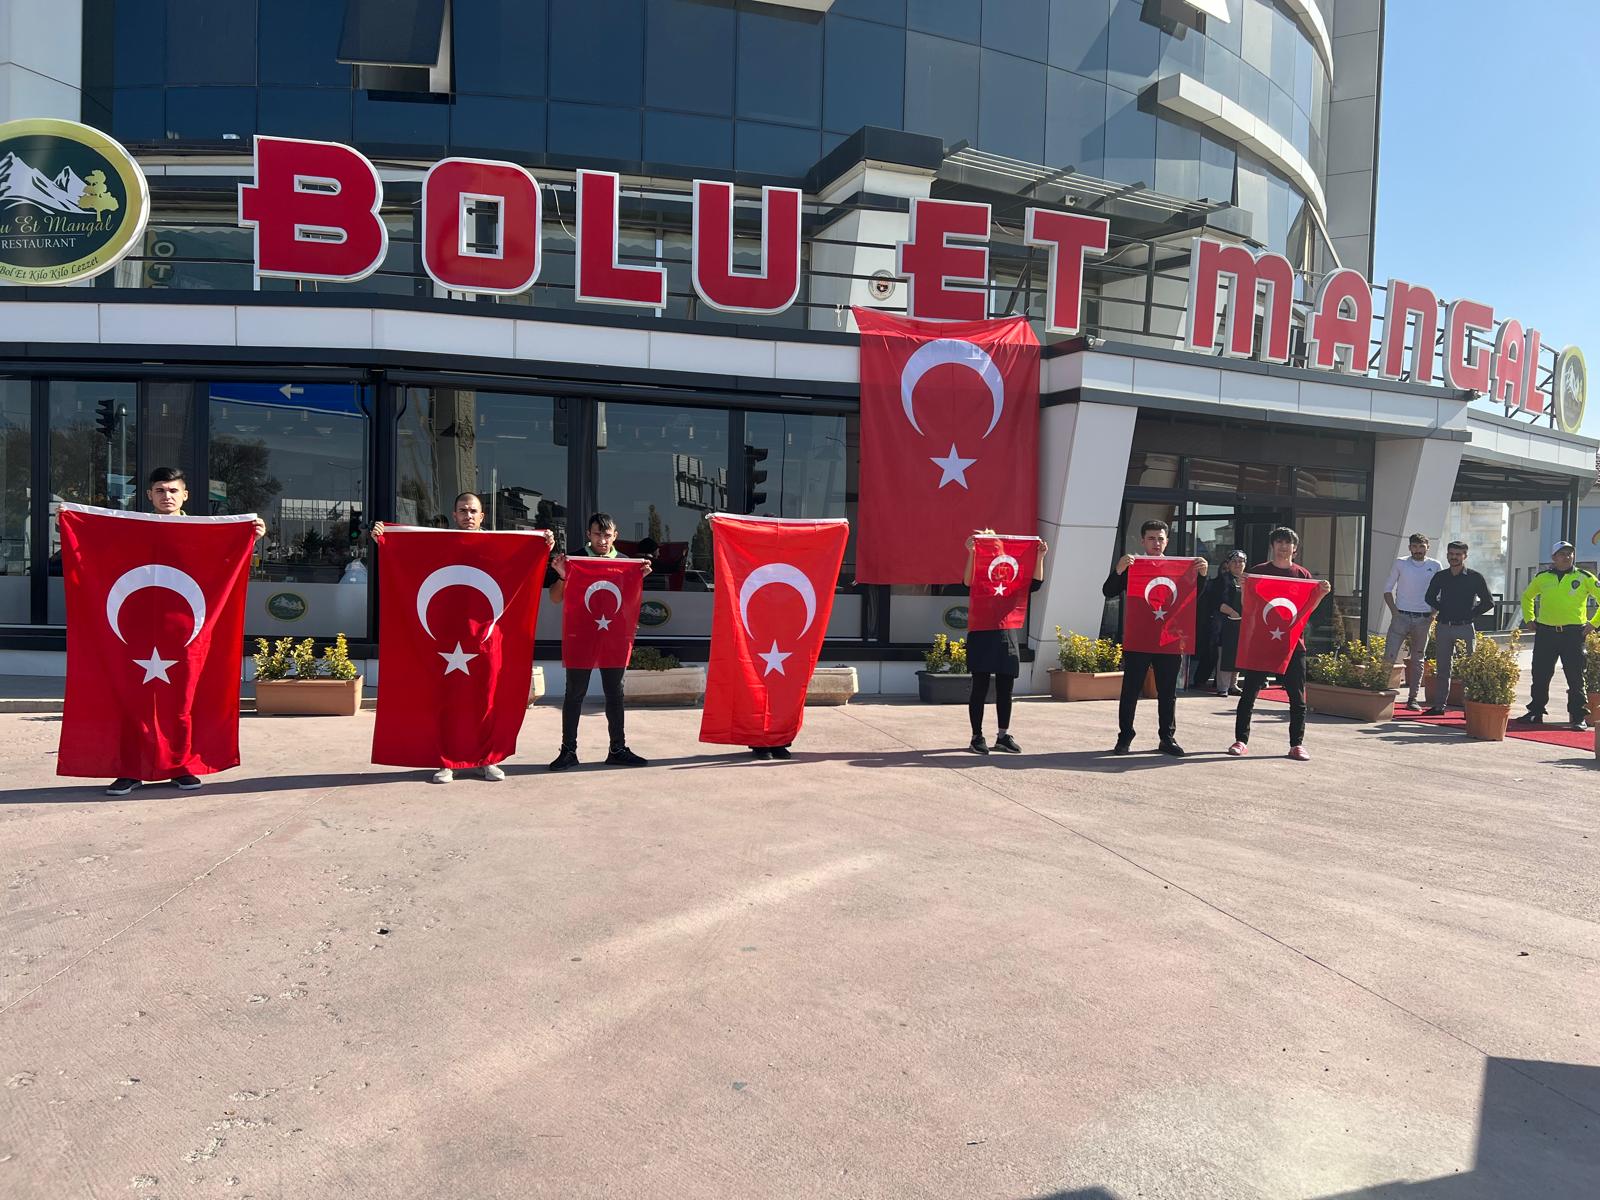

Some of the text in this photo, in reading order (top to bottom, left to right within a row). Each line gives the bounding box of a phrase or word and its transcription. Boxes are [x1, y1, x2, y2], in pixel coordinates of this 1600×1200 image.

[15, 215, 40, 234] Et
[43, 214, 114, 238] Mangal
[1, 237, 77, 249] RESTAURANT
[15, 269, 26, 279] Et
[71, 256, 98, 274] Lezzet
[237, 134, 1546, 416] BOLU ET MANGAL
